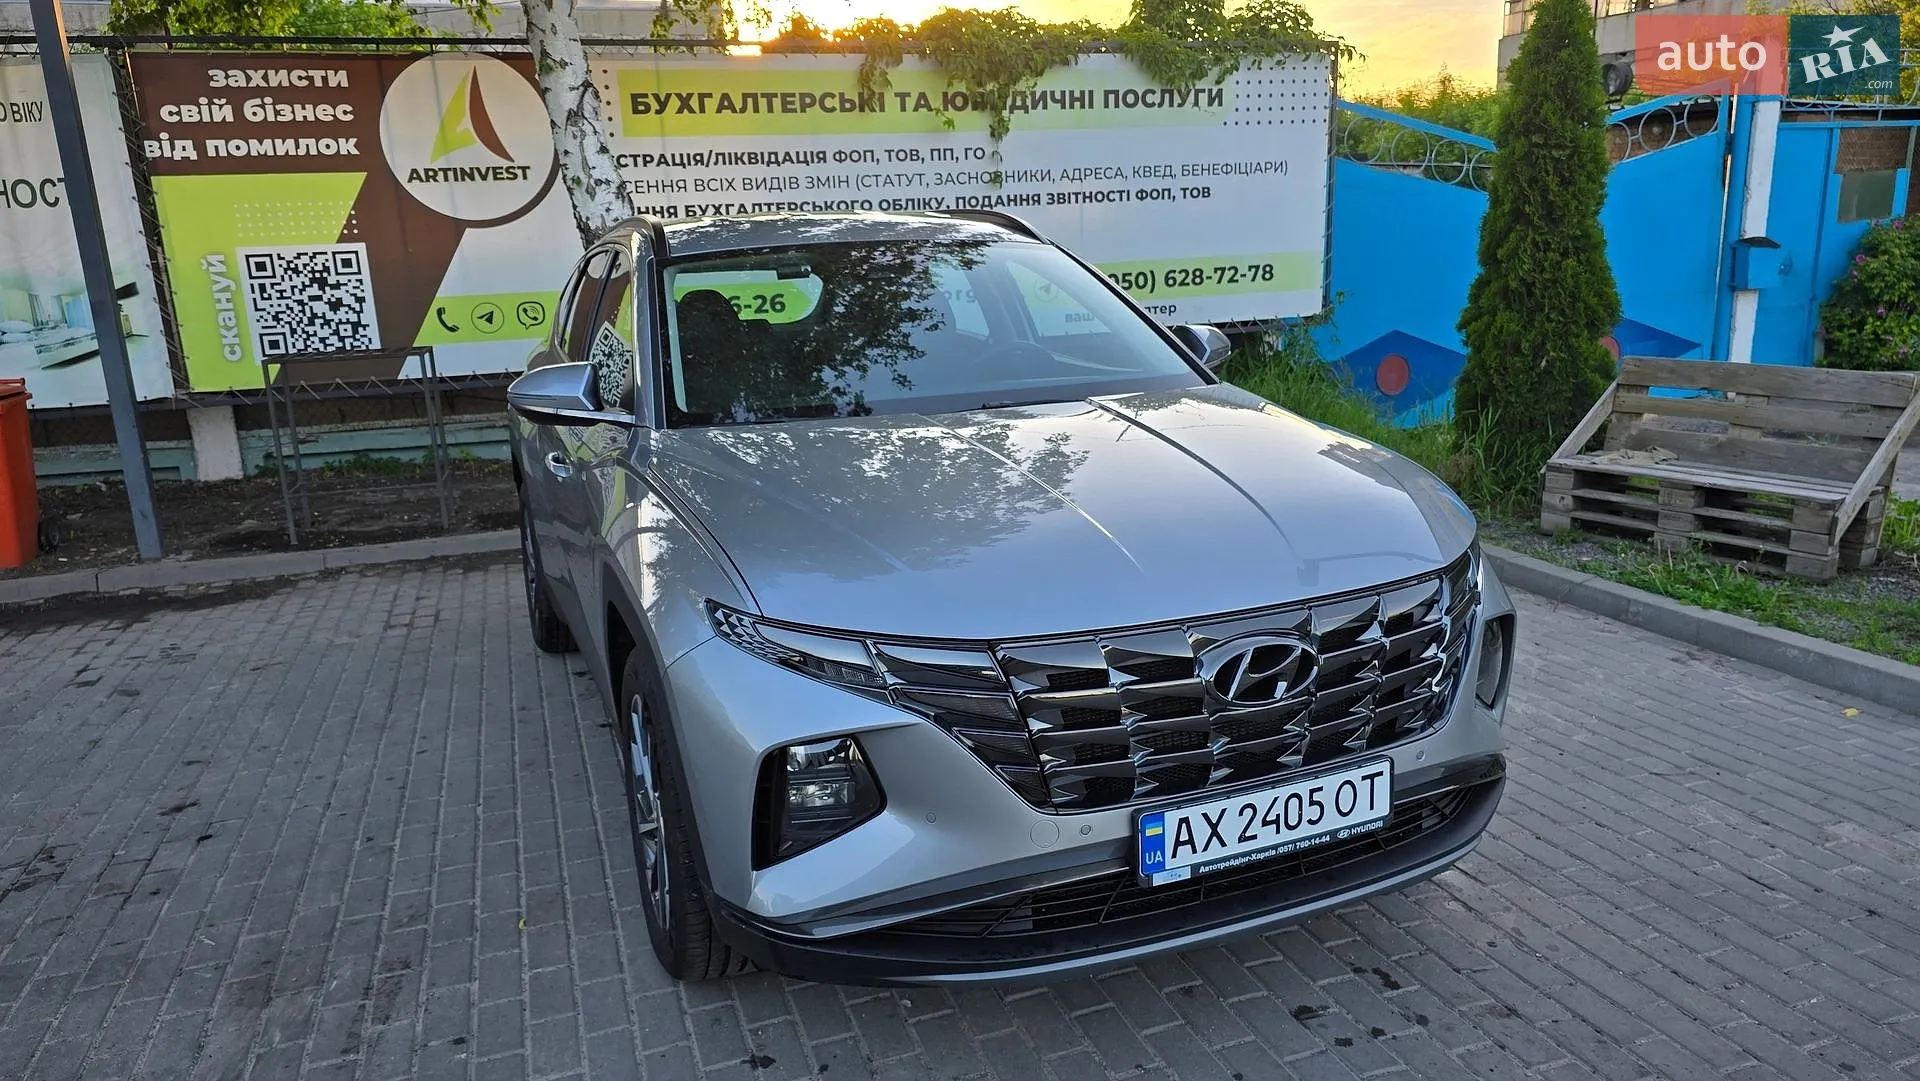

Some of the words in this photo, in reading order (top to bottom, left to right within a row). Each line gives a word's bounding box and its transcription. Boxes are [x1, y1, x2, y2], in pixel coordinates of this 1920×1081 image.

[208, 69, 349, 88] захисти
[9, 101, 43, 123] ВІКУ
[160, 96, 234, 123] свій
[243, 97, 354, 122] бізнес
[630, 91, 886, 115] БУХГАЛТЕРСЬКІ
[894, 91, 934, 113] ТА
[942, 89, 1094, 115] ЮДИЧНІ
[1103, 87, 1224, 110] ПОСЛУГИ
[143, 132, 198, 160] від
[205, 137, 361, 157] помилок
[613, 149, 827, 169] СТРАЦІЯ/ЛІКВІДАЦІЯ
[833, 148, 880, 166] ФОП,
[884, 148, 925, 164] ТОВ,
[930, 147, 959, 163] ПП,
[964, 146, 985, 161] ГО
[407, 165, 531, 183] ARTINVEST
[694, 177, 737, 193] ВСІХ
[743, 175, 800, 193] ВИДІВ
[805, 174, 850, 190] ЗМІН
[856, 172, 930, 191] (СТАТУТ,
[1059, 166, 1128, 183] АДРЕСА,
[1132, 164, 1177, 180] КВЕД,
[1181, 159, 1288, 177] БЕНЕФІЦІАРИ)
[684, 199, 873, 218] БУХГАЛТЕРСЬКОГО
[956, 193, 1041, 210] ПОДАННЯ
[1046, 189, 1130, 206] ЗВІТНОСТІ
[1135, 187, 1176, 202] ФОП,
[1180, 186, 1211, 200] ТОВ
[1164, 263, 1274, 288] 628-72-78
[200, 254, 243, 362] скануй
[1170, 808, 1228, 860] AX
[1237, 785, 1325, 844] 2405
[1334, 770, 1384, 818] OT
[1351, 820, 1384, 835] HYUNDAI
[1145, 851, 1163, 865] UA
